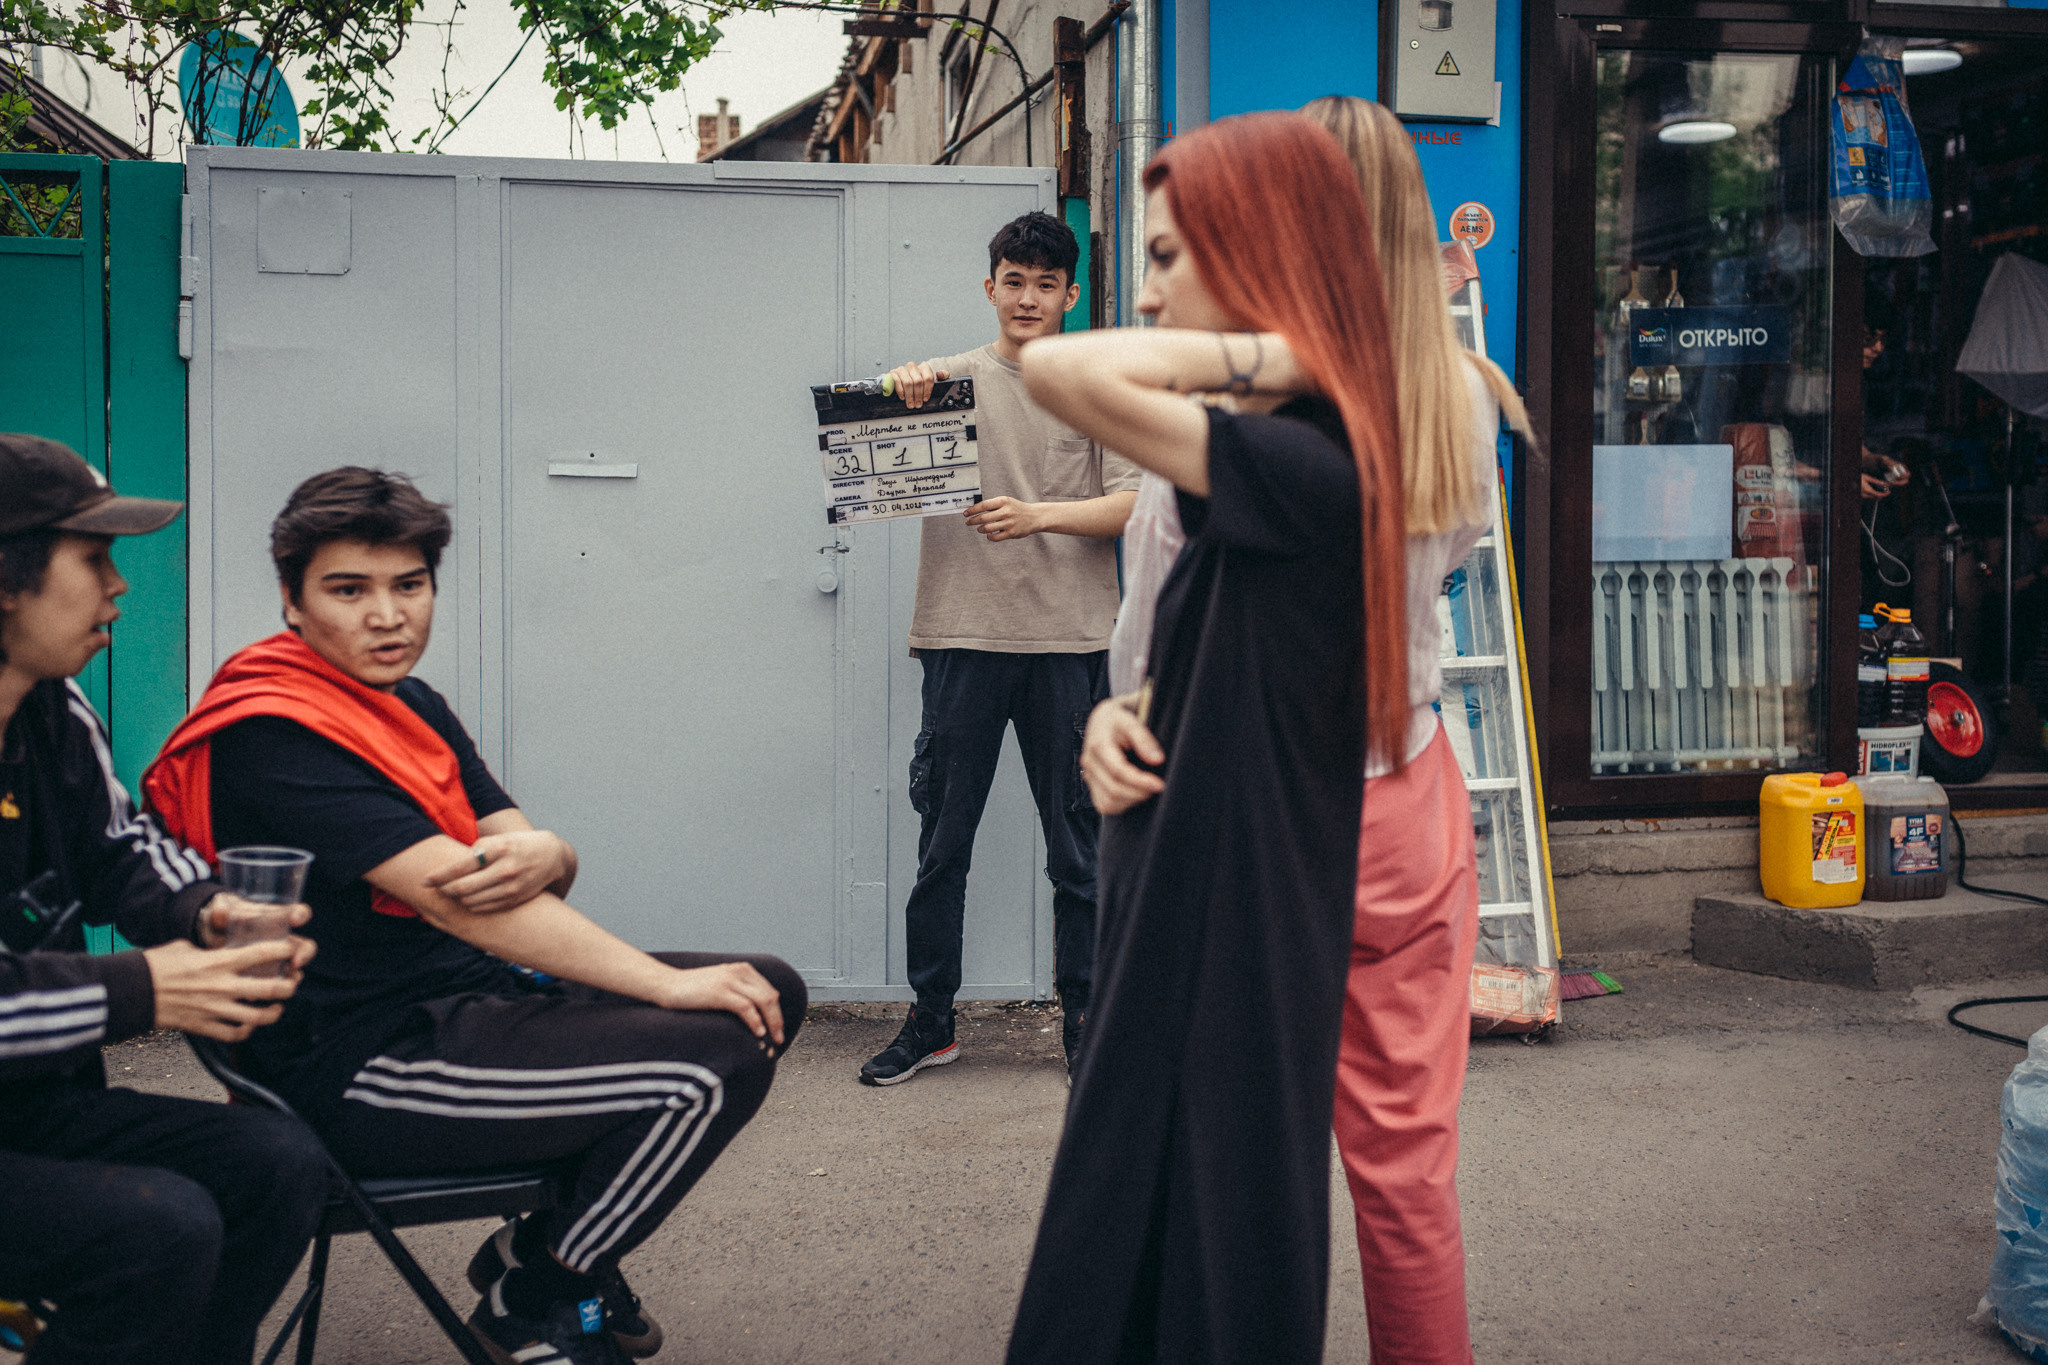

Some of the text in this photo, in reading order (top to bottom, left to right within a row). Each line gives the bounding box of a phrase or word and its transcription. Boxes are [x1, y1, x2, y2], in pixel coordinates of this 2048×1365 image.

[1460, 225, 1484, 233] AEMS
[1639, 334, 1664, 343] Dulux
[1679, 327, 1768, 348] ОТКРЫТО
[935, 435, 955, 443] TAKE
[876, 442, 896, 450] SHOT
[942, 441, 962, 460] 1
[828, 447, 853, 455] SCENE
[892, 447, 913, 467] 1
[834, 455, 867, 476] 32
[832, 480, 865, 489] DIRECTOR
[834, 494, 862, 502] CAMERA
[1871, 741, 1906, 749] HIDROFLEX
[1908, 827, 1924, 836] 4F
